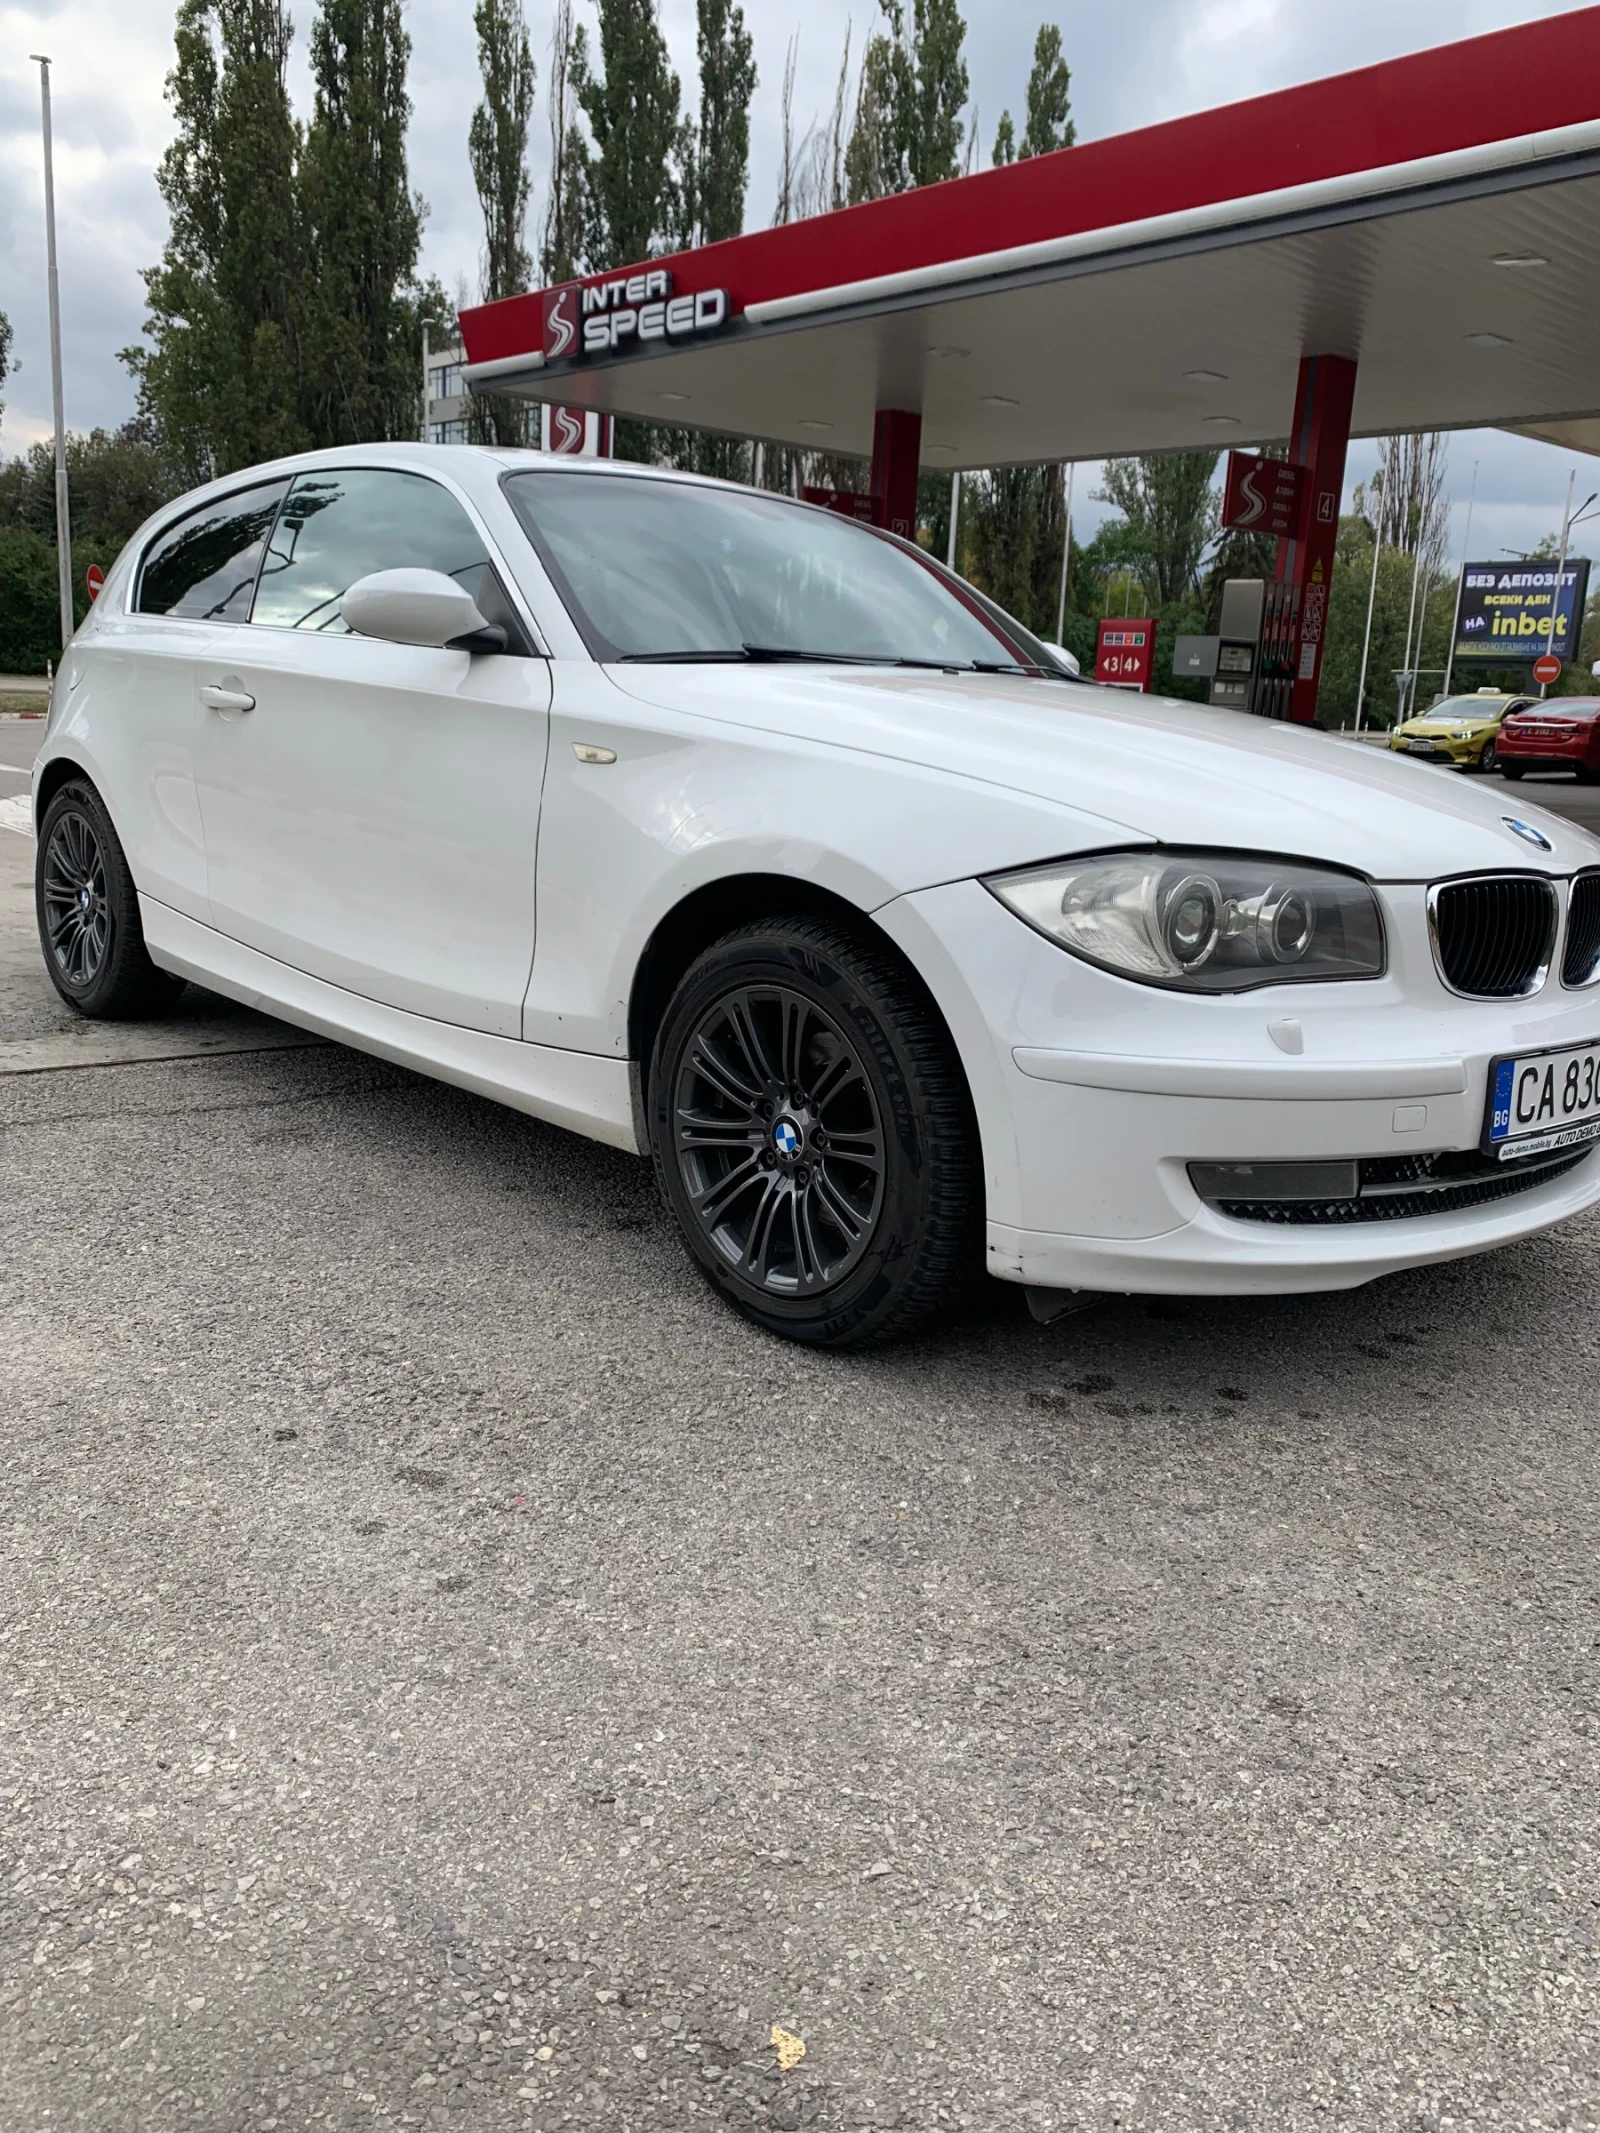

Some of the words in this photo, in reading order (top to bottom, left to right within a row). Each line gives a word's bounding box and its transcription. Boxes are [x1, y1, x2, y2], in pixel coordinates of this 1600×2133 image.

[582, 269, 667, 313] INTER
[583, 287, 726, 351] SPEED
[1321, 496, 1331, 518] 4
[1466, 574, 1496, 588] БЕЗ
[1498, 572, 1577, 589] ДЕПОЗИТ
[1484, 594, 1523, 606] ВСЕКИ
[1525, 594, 1551, 606] ДЕН
[1465, 616, 1485, 630] НА
[1492, 610, 1568, 636] inbet
[1110, 656, 1119, 672] 3
[1124, 656, 1133, 672] 4
[1516, 1062, 1555, 1124] CA
[1493, 1109, 1509, 1128] BG
[1553, 1130, 1577, 1147] AUTO
